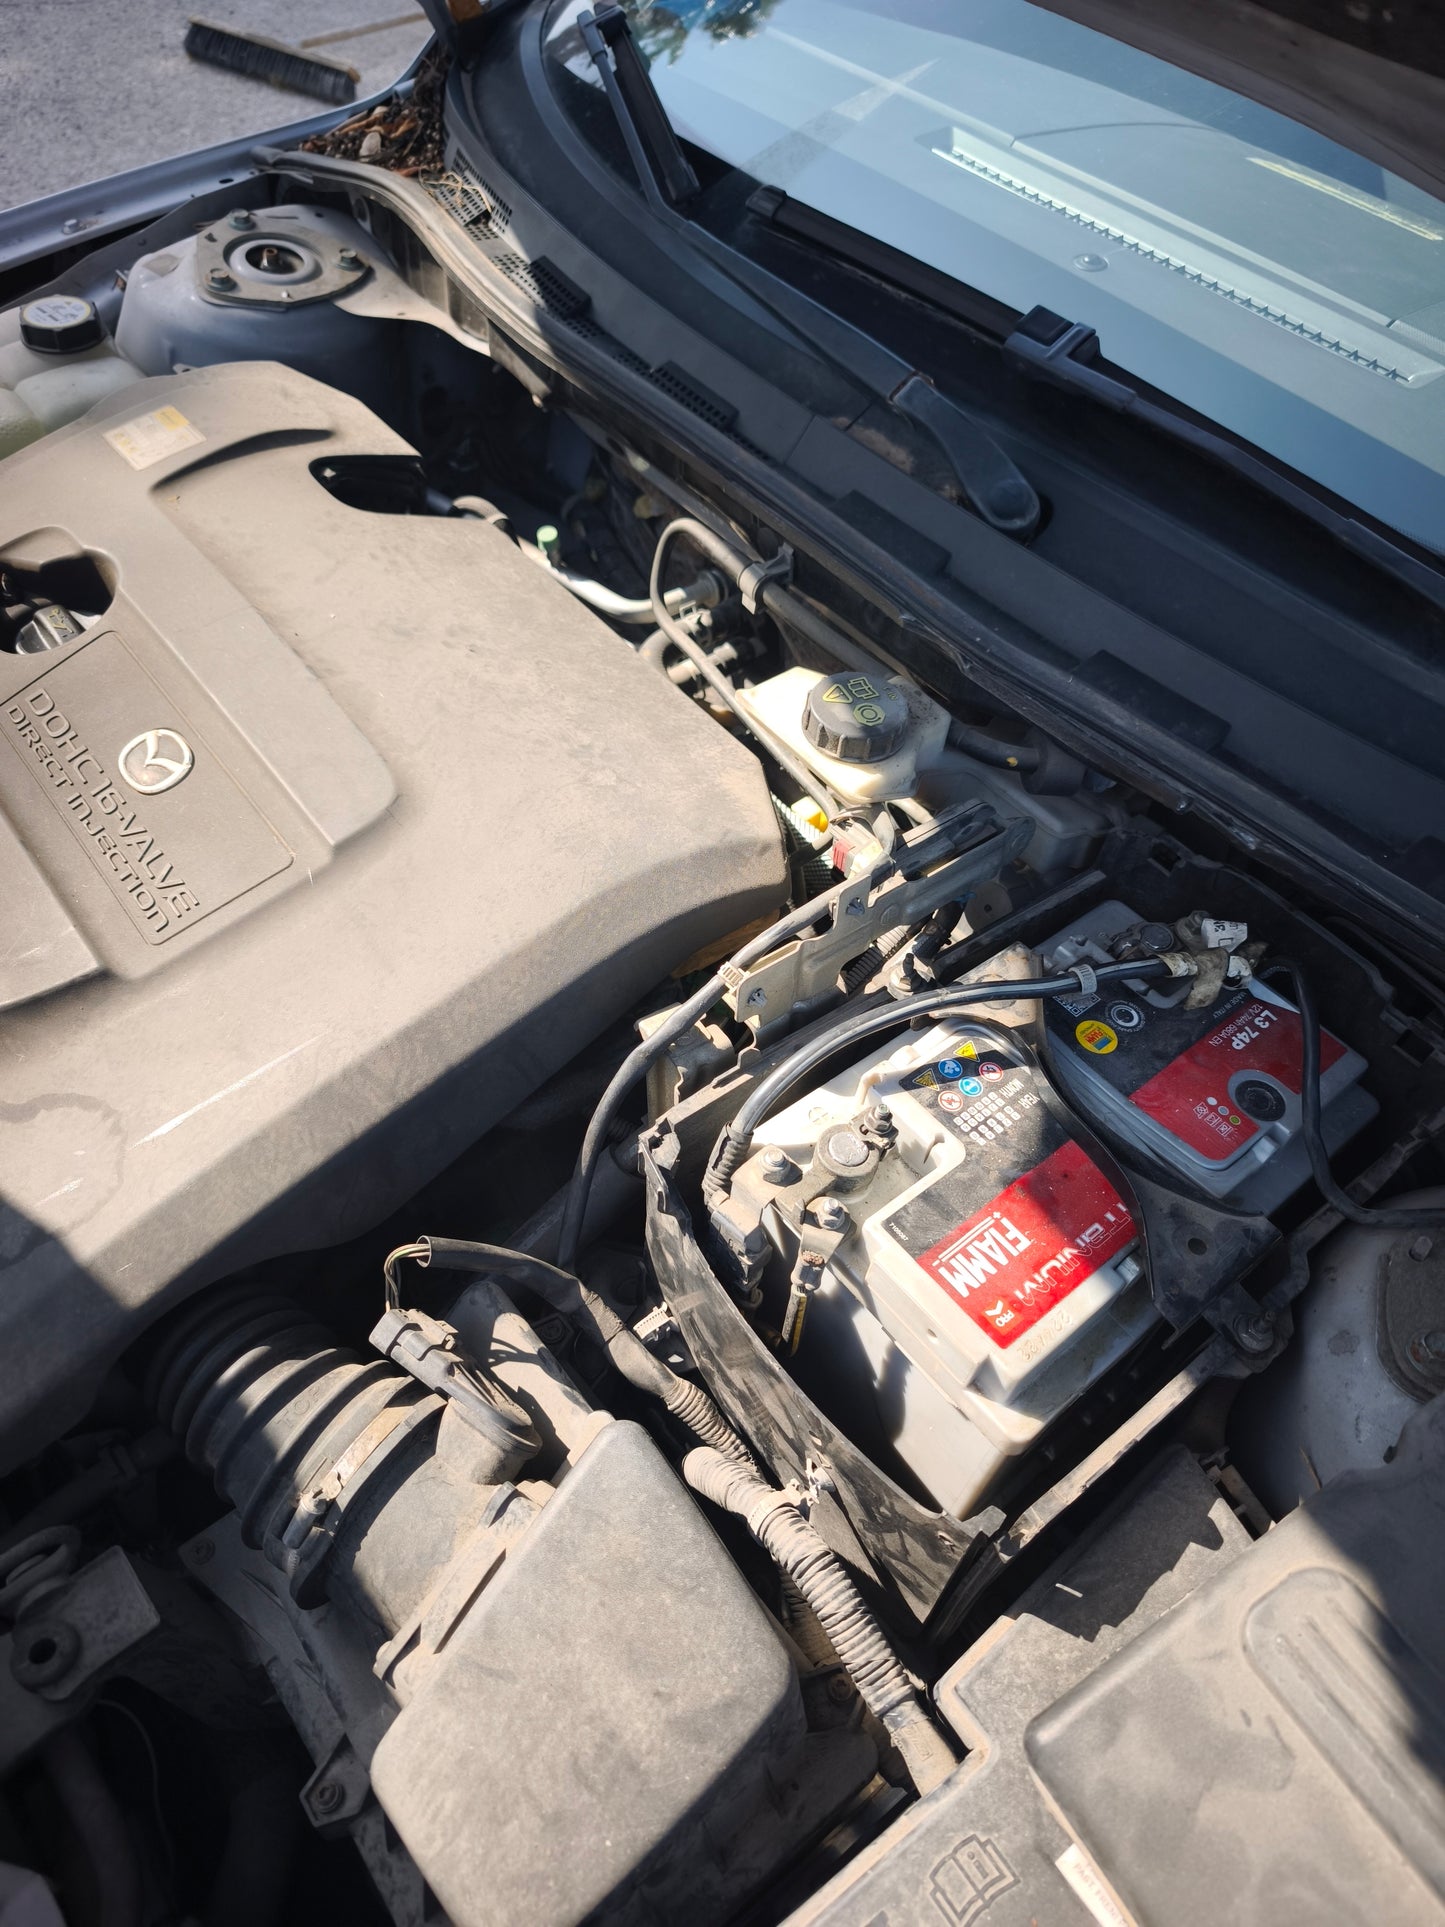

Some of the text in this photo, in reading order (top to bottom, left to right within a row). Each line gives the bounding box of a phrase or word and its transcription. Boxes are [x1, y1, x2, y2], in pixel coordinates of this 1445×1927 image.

[9, 705, 73, 787] DIRECT
[27, 688, 200, 918] DOHC 16-VALVE
[1231, 1009, 1278, 1050] L3 74P
[998, 1078, 1024, 1098] MONTH
[1018, 1092, 1040, 1109] YEAR
[939, 1219, 1033, 1298] FIAMM
[995, 1309, 1015, 1327] PRO
[273, 1385, 320, 1428] TOP
